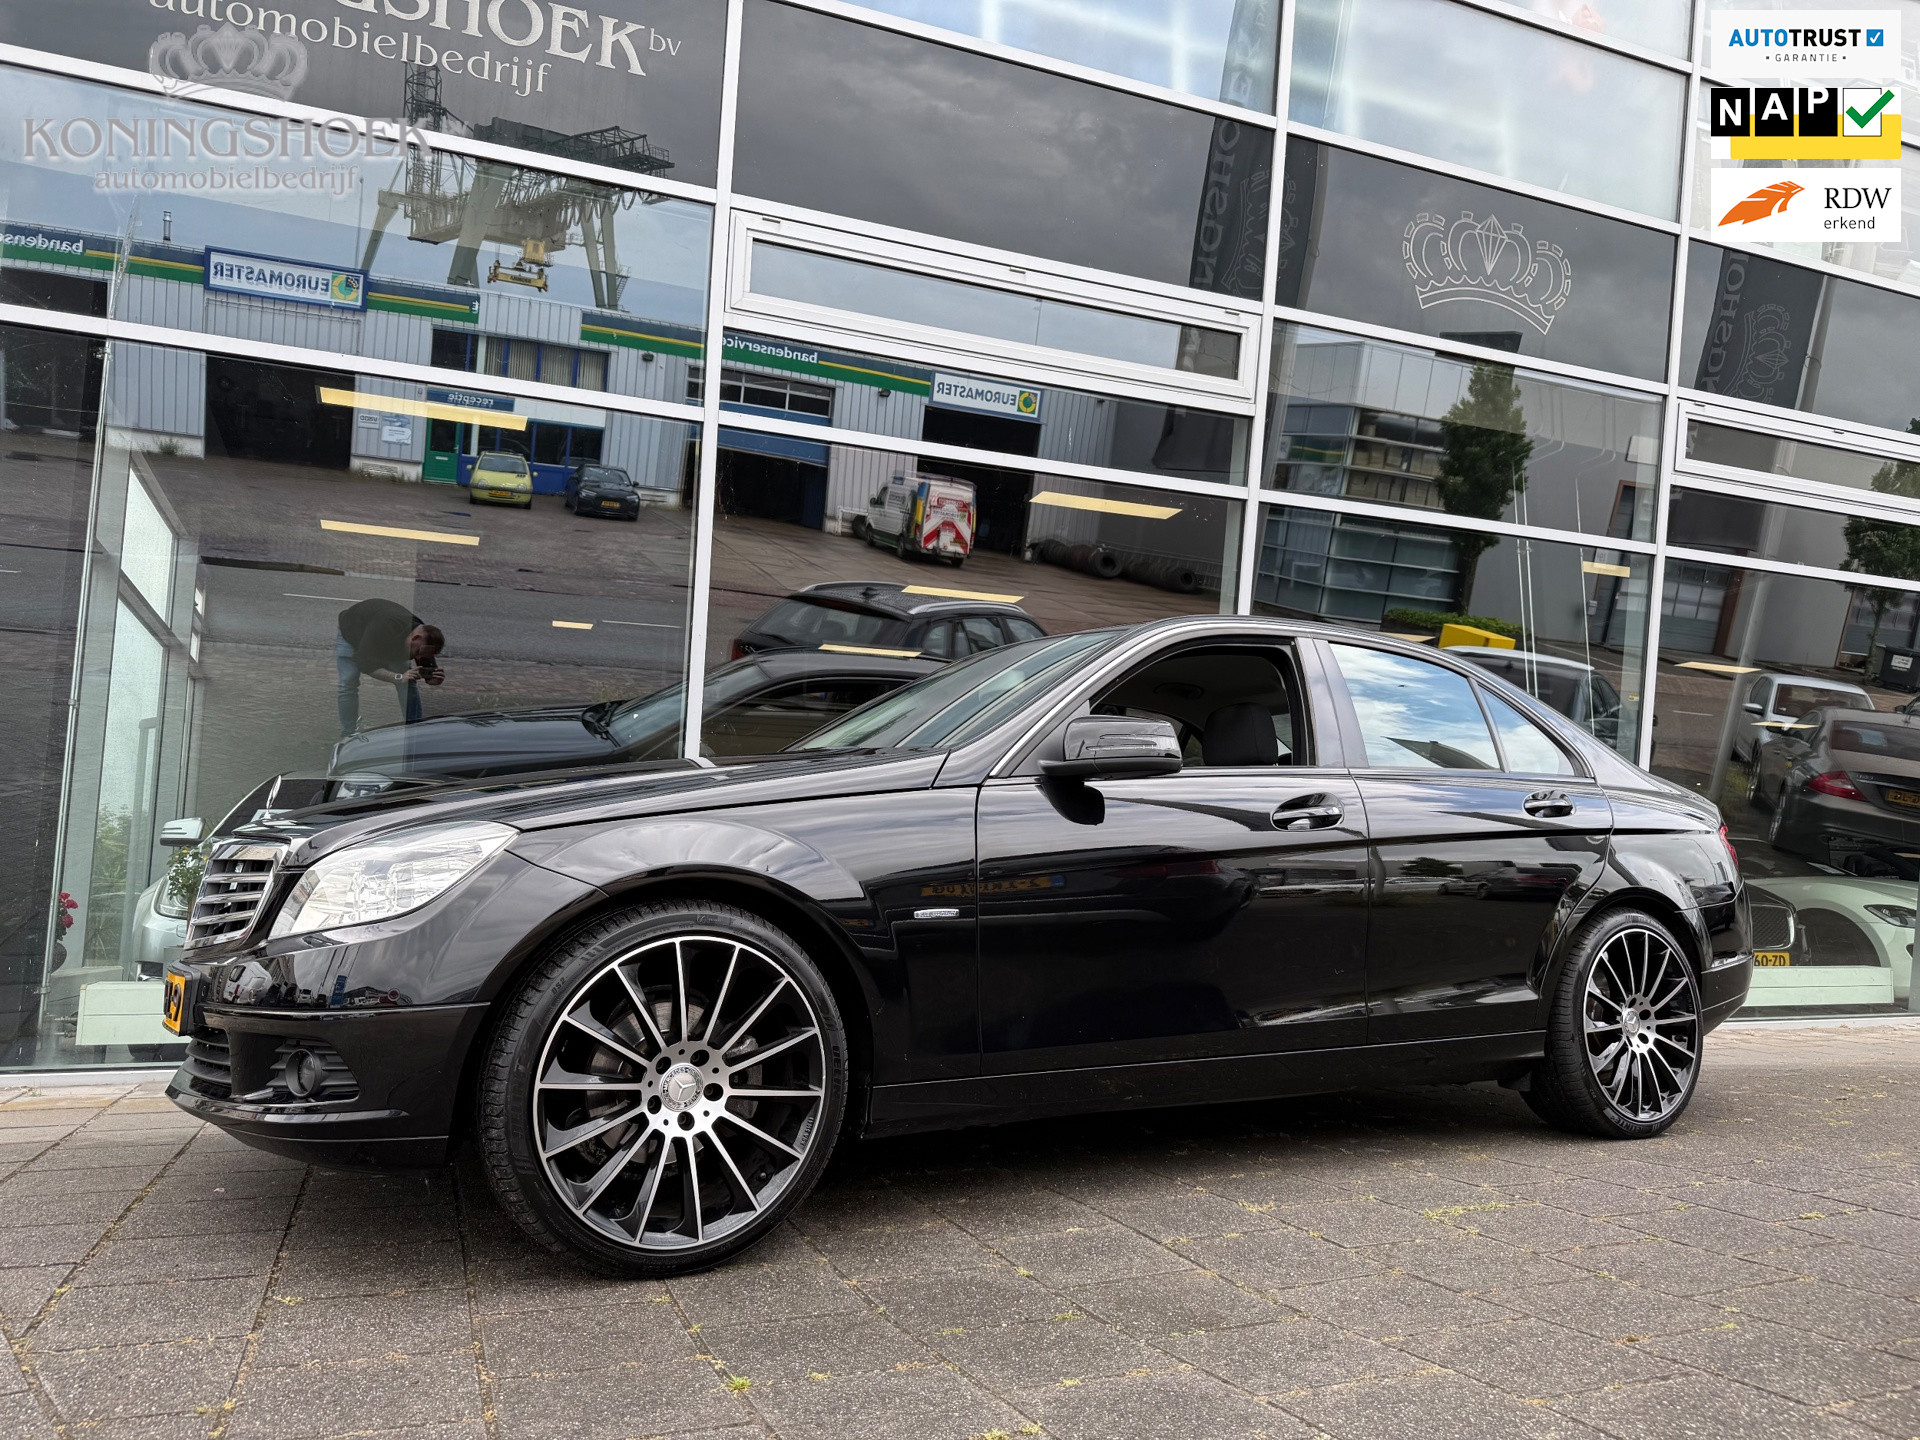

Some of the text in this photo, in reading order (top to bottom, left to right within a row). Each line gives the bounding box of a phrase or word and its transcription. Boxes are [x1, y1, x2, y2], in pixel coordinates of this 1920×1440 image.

[333, 0, 682, 77] HOEK bv
[1754, 954, 1786, 967] 60-ZD
